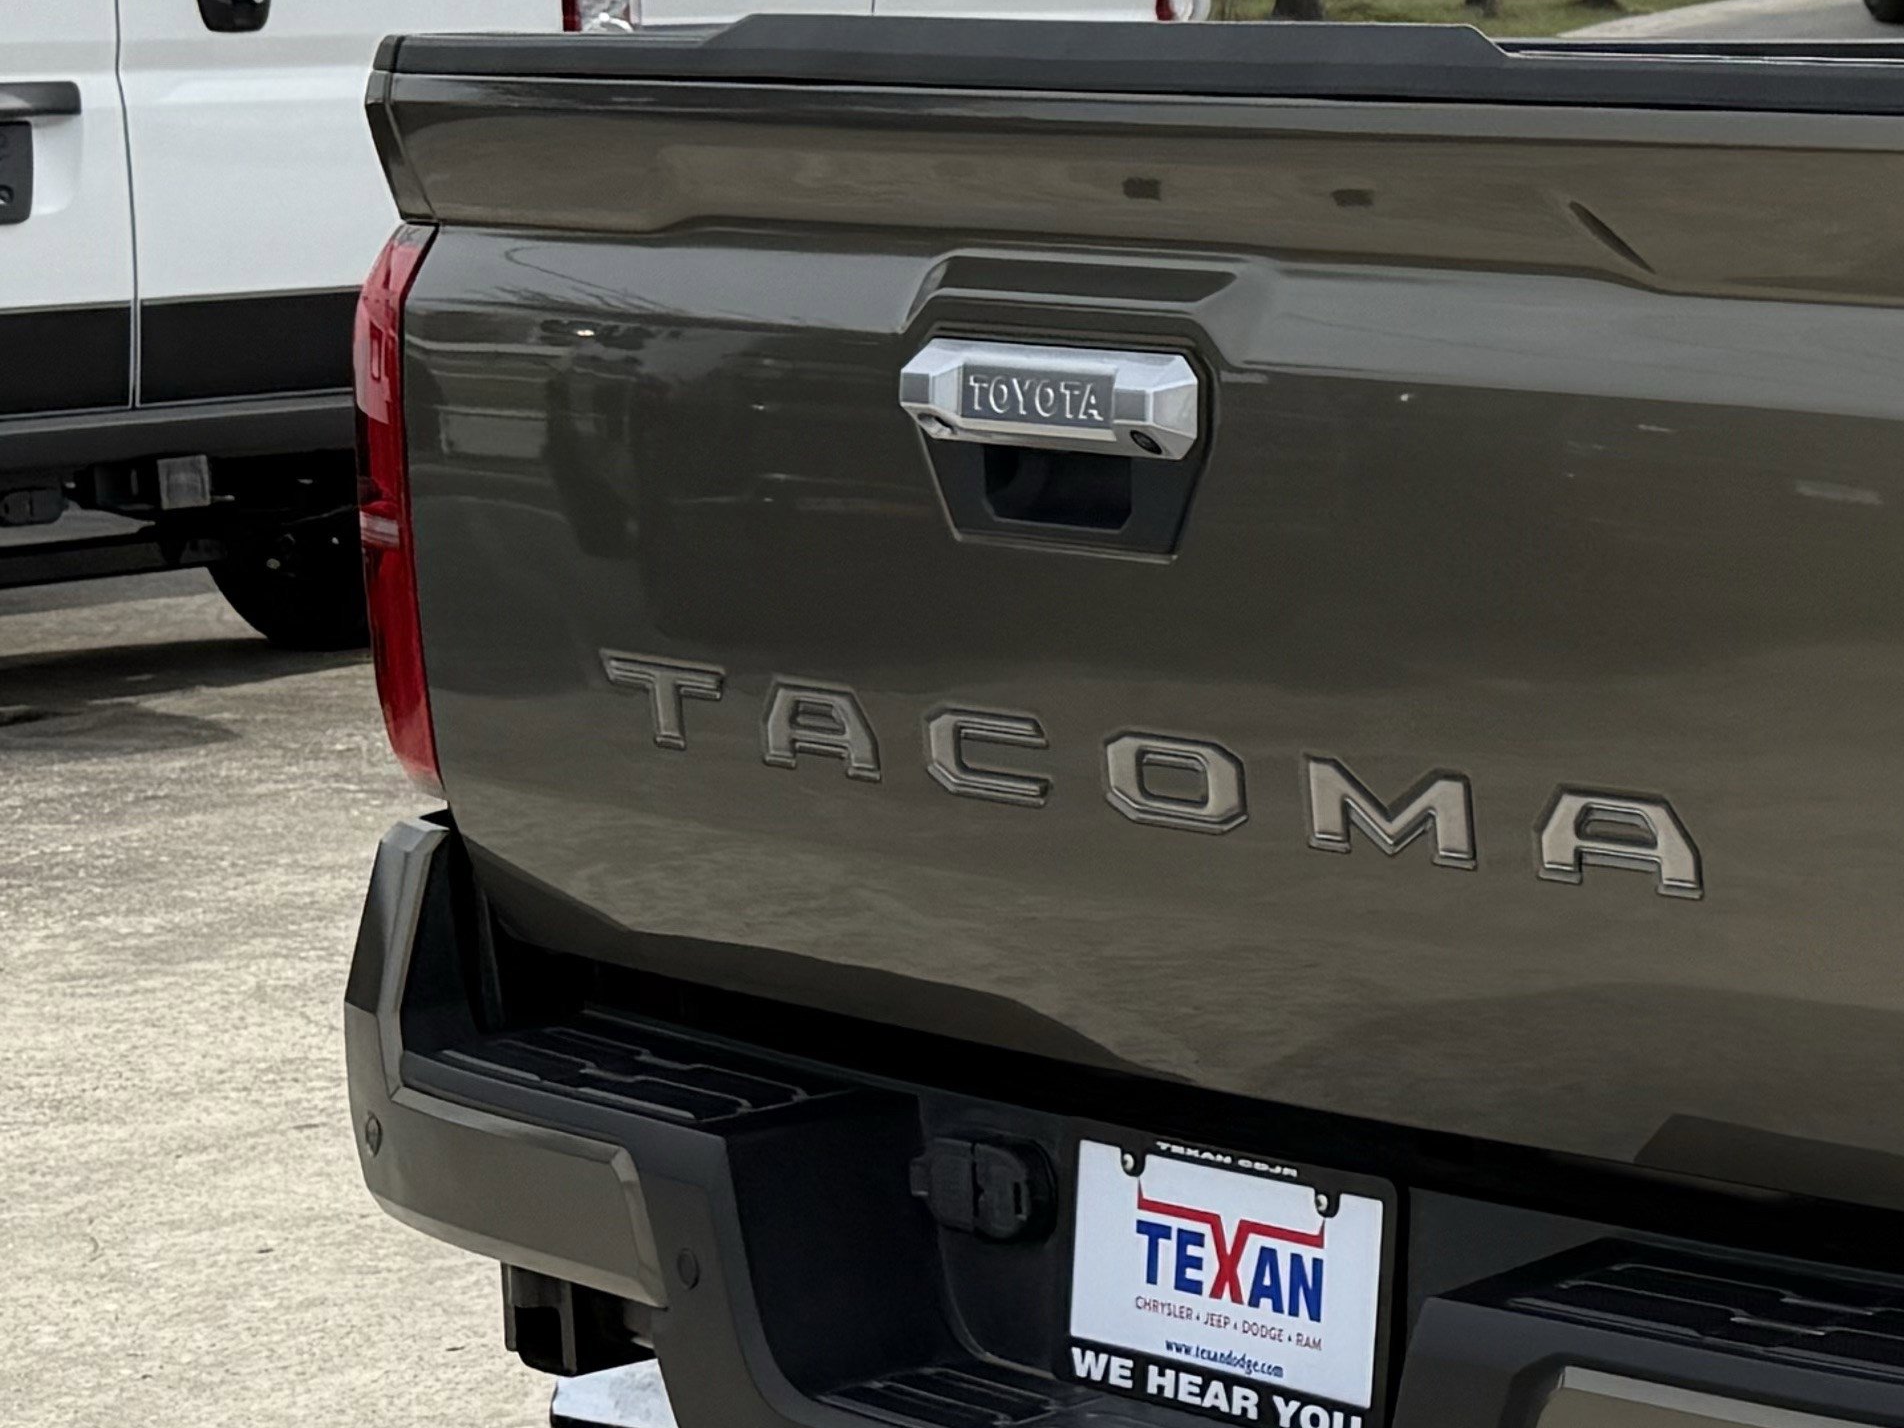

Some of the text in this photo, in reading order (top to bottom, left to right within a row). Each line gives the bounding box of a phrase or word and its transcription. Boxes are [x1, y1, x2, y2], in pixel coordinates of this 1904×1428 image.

[968, 374, 1105, 422] TOYOTA
[601, 650, 1704, 901] TACOMA
[1156, 1140, 1233, 1165] TEXAN
[1136, 1184, 1325, 1324] TEXAN
[1135, 1295, 1322, 1351] CHRYSLER JEEP DODGE RAM
[1070, 1346, 1135, 1389] WE
[1147, 1364, 1259, 1421] HEAR
